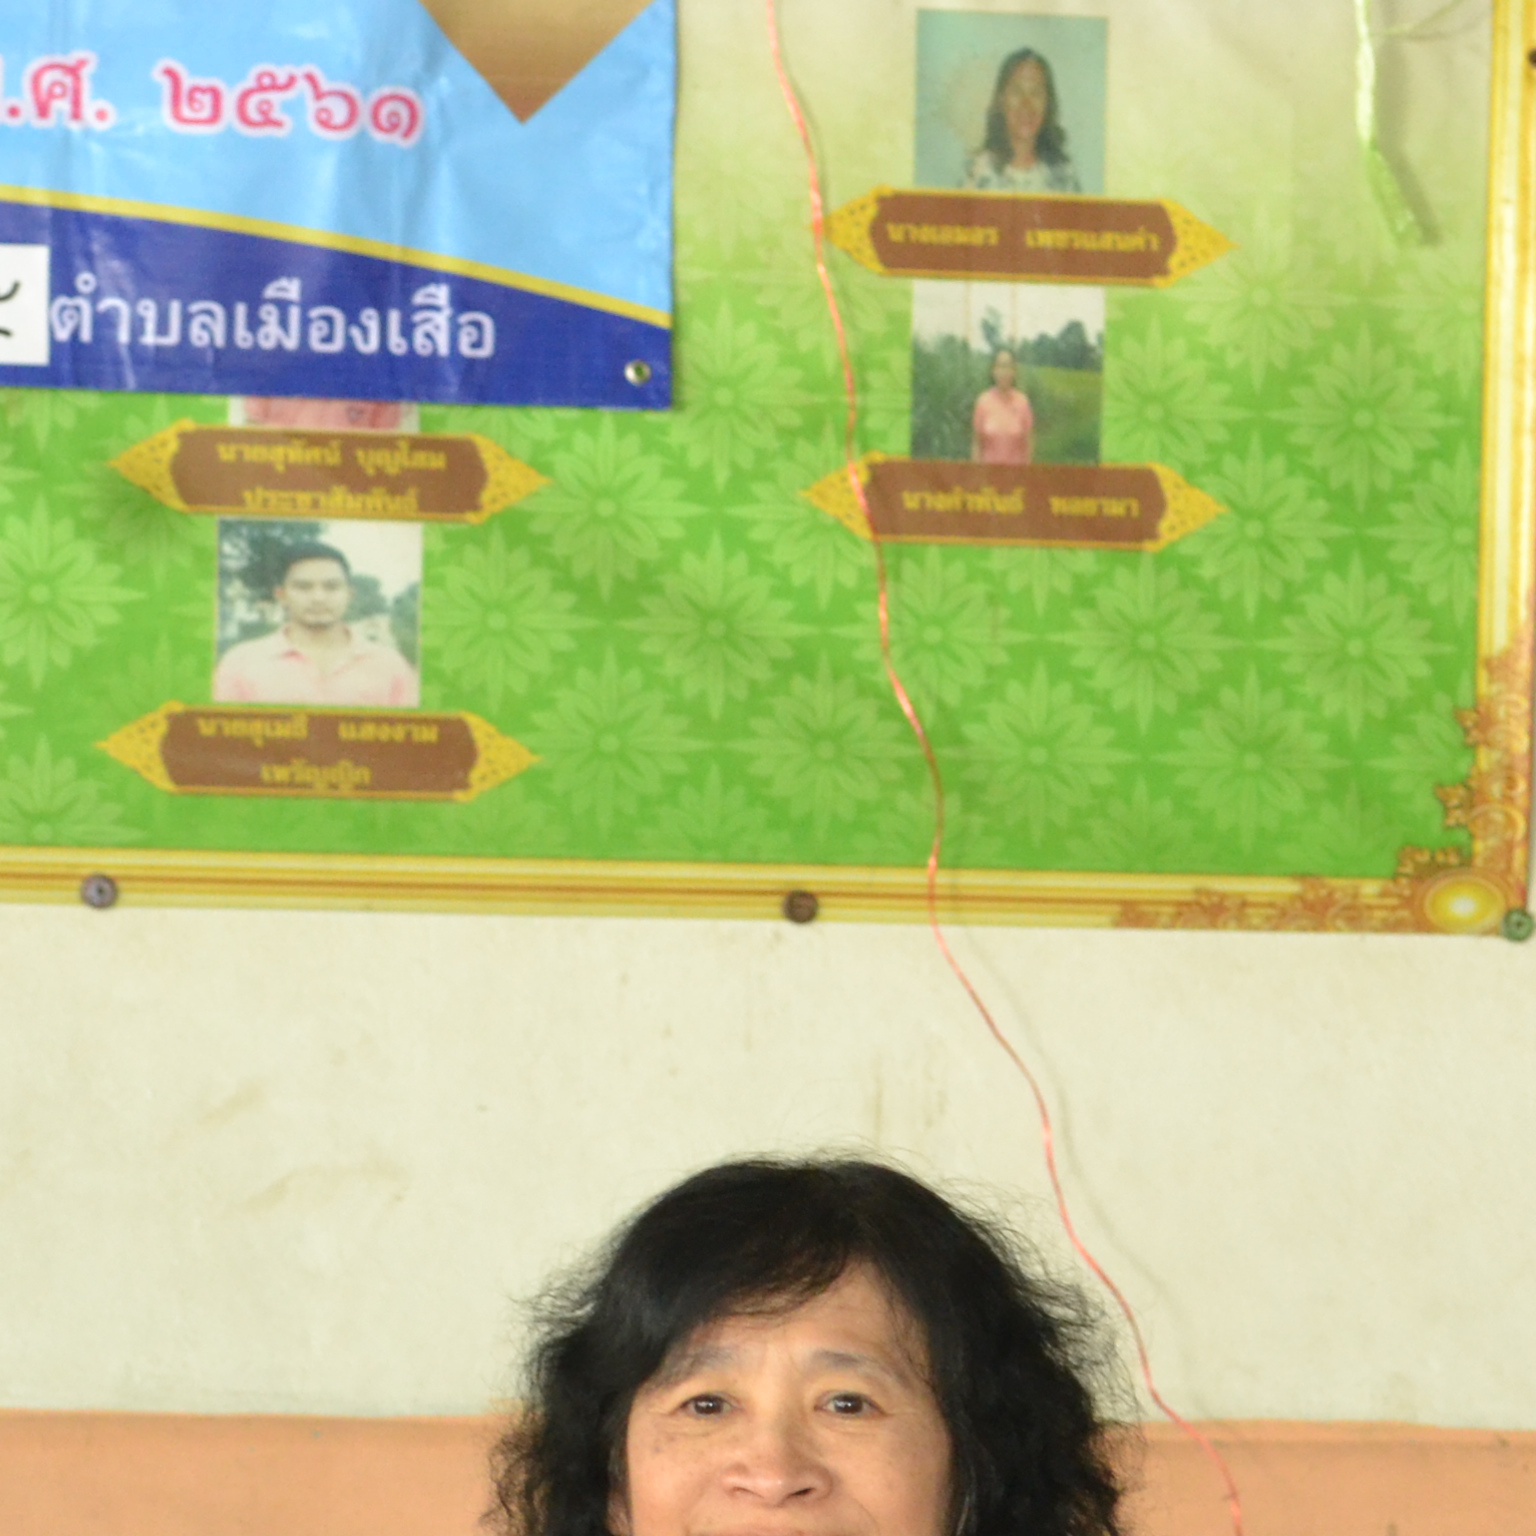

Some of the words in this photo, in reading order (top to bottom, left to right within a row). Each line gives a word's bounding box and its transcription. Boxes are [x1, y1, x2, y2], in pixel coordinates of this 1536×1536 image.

[162, 64, 422, 142] ๒๕๖๑
[49, 268, 495, 360] ตำบลเมืองเสือ
